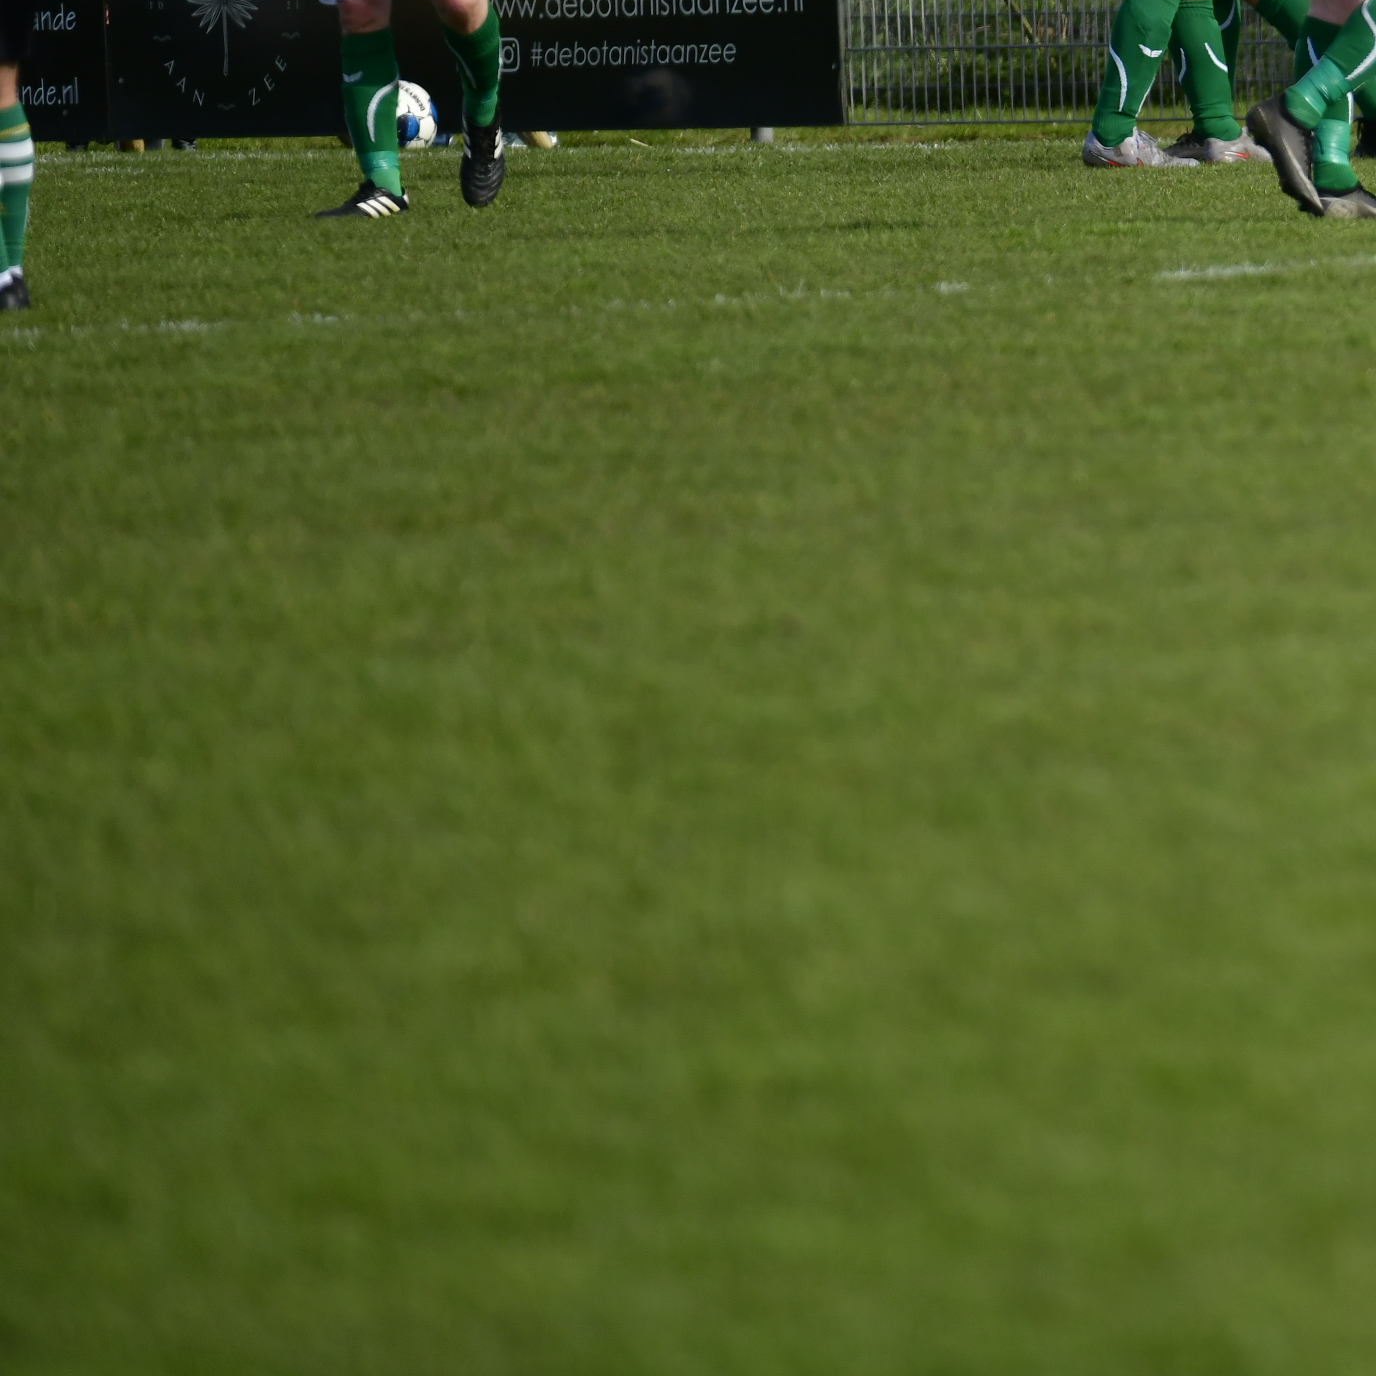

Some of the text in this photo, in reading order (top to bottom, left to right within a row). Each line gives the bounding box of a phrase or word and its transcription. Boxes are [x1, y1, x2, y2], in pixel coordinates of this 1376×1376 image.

[530, 39, 737, 67] #debotanistaanzee
[18, 77, 79, 106] nde.nl
[164, 59, 205, 106] AAN
[249, 55, 287, 106] ZEE
